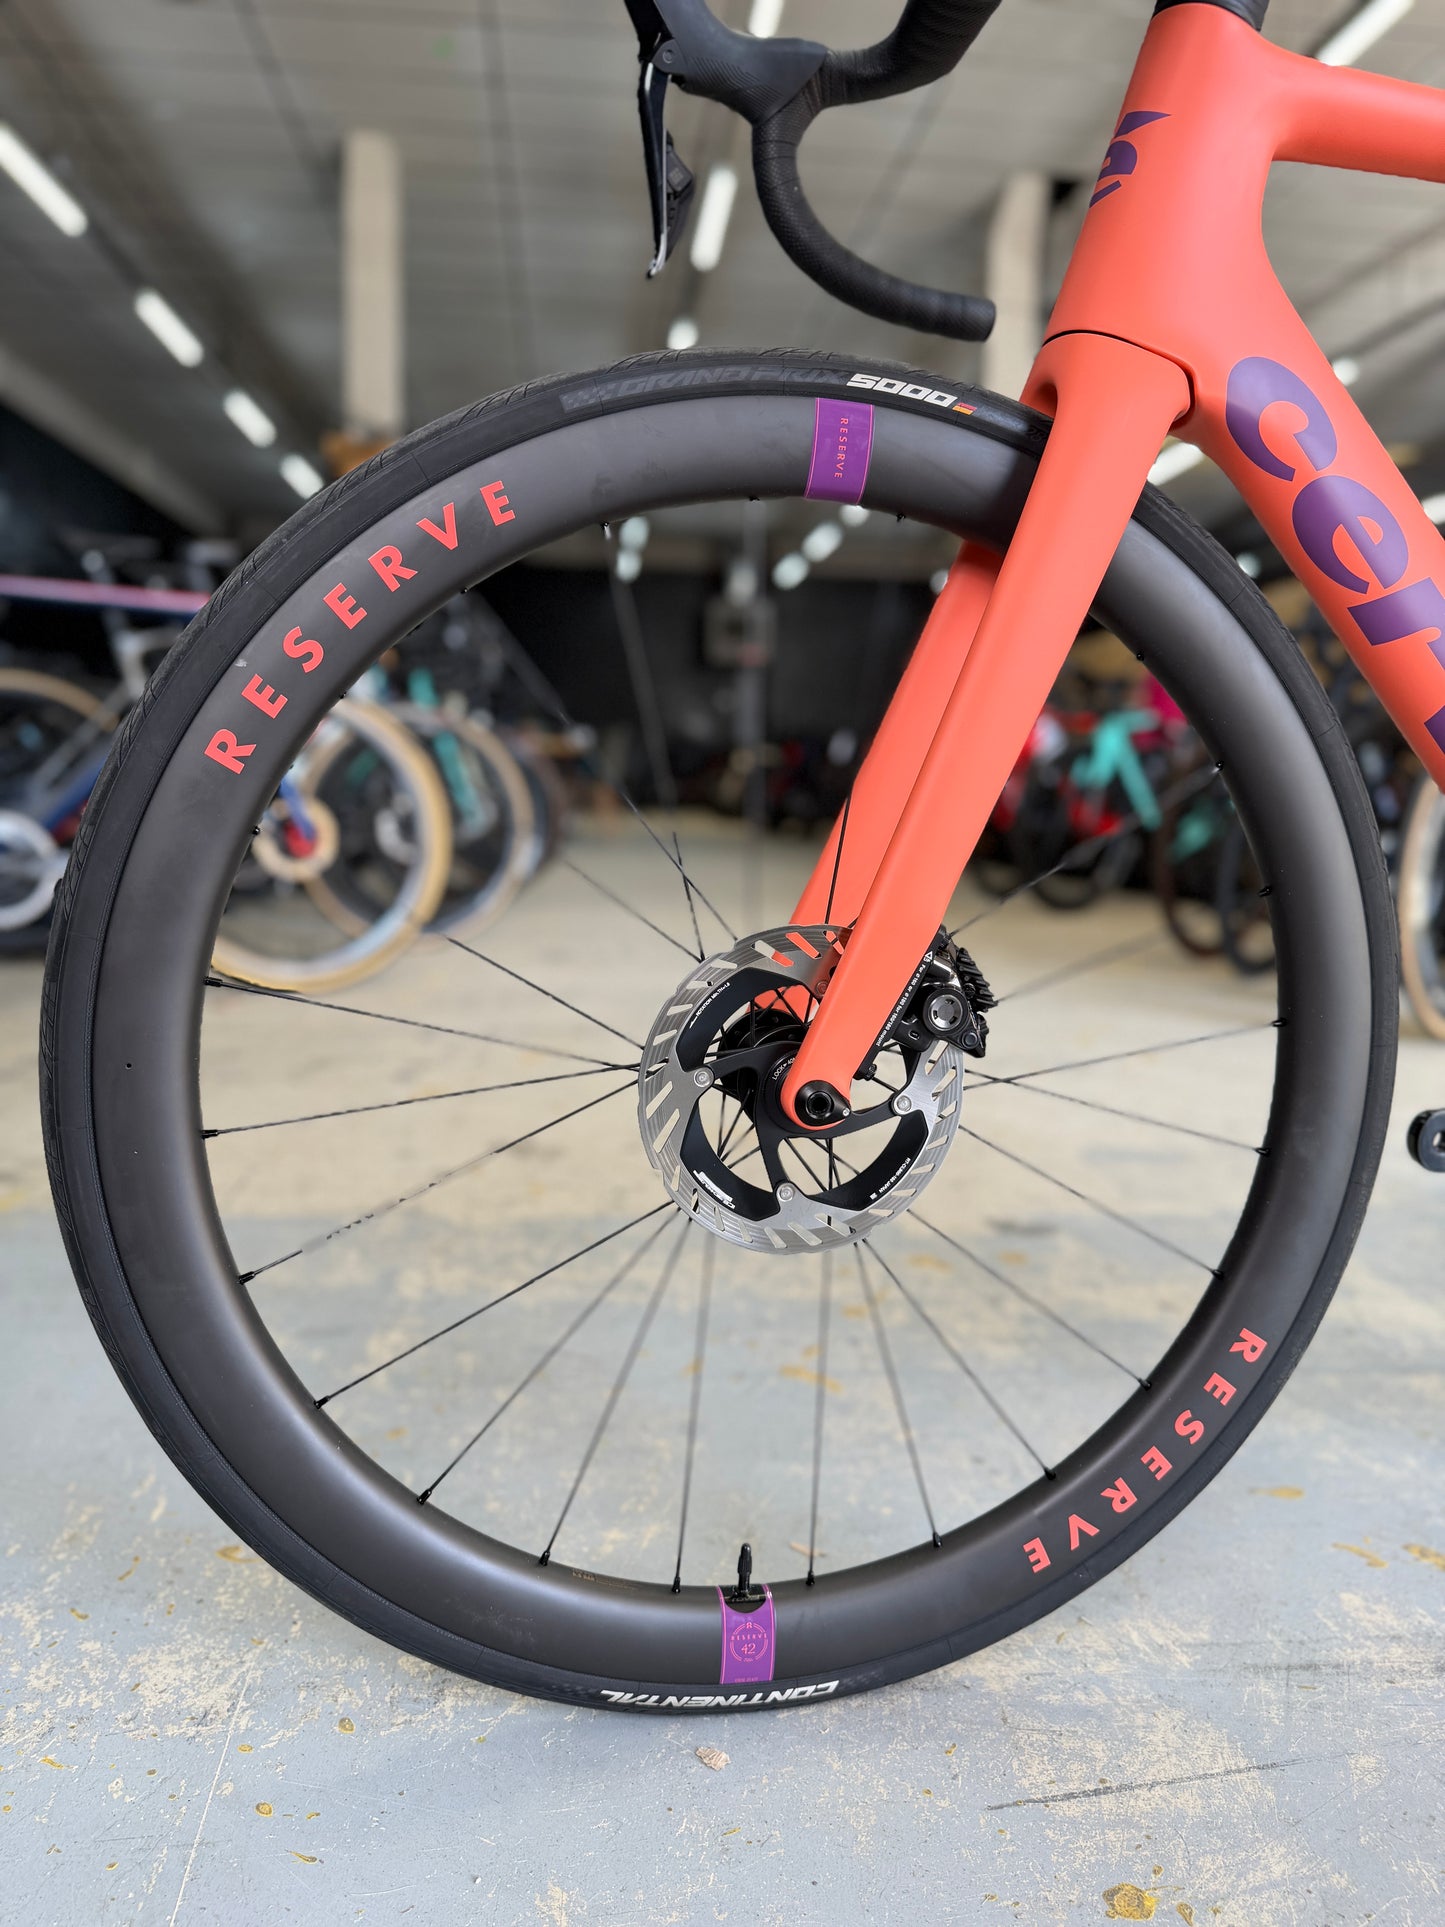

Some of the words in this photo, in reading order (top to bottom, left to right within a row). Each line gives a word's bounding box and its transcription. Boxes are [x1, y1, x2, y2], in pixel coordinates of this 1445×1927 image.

[617, 366, 746, 397] GRAND
[847, 373, 957, 407] 5000
[834, 417, 849, 480] RESERVE
[1225, 356, 1445, 755] cer
[204, 481, 515, 774] RESERVE
[772, 1064, 785, 1080] LOCK
[1024, 1329, 1266, 1572] RESERVE
[731, 1633, 767, 1641] RESERVE
[741, 1643, 756, 1655] 42
[600, 1679, 840, 1708] CONTINENTAL
